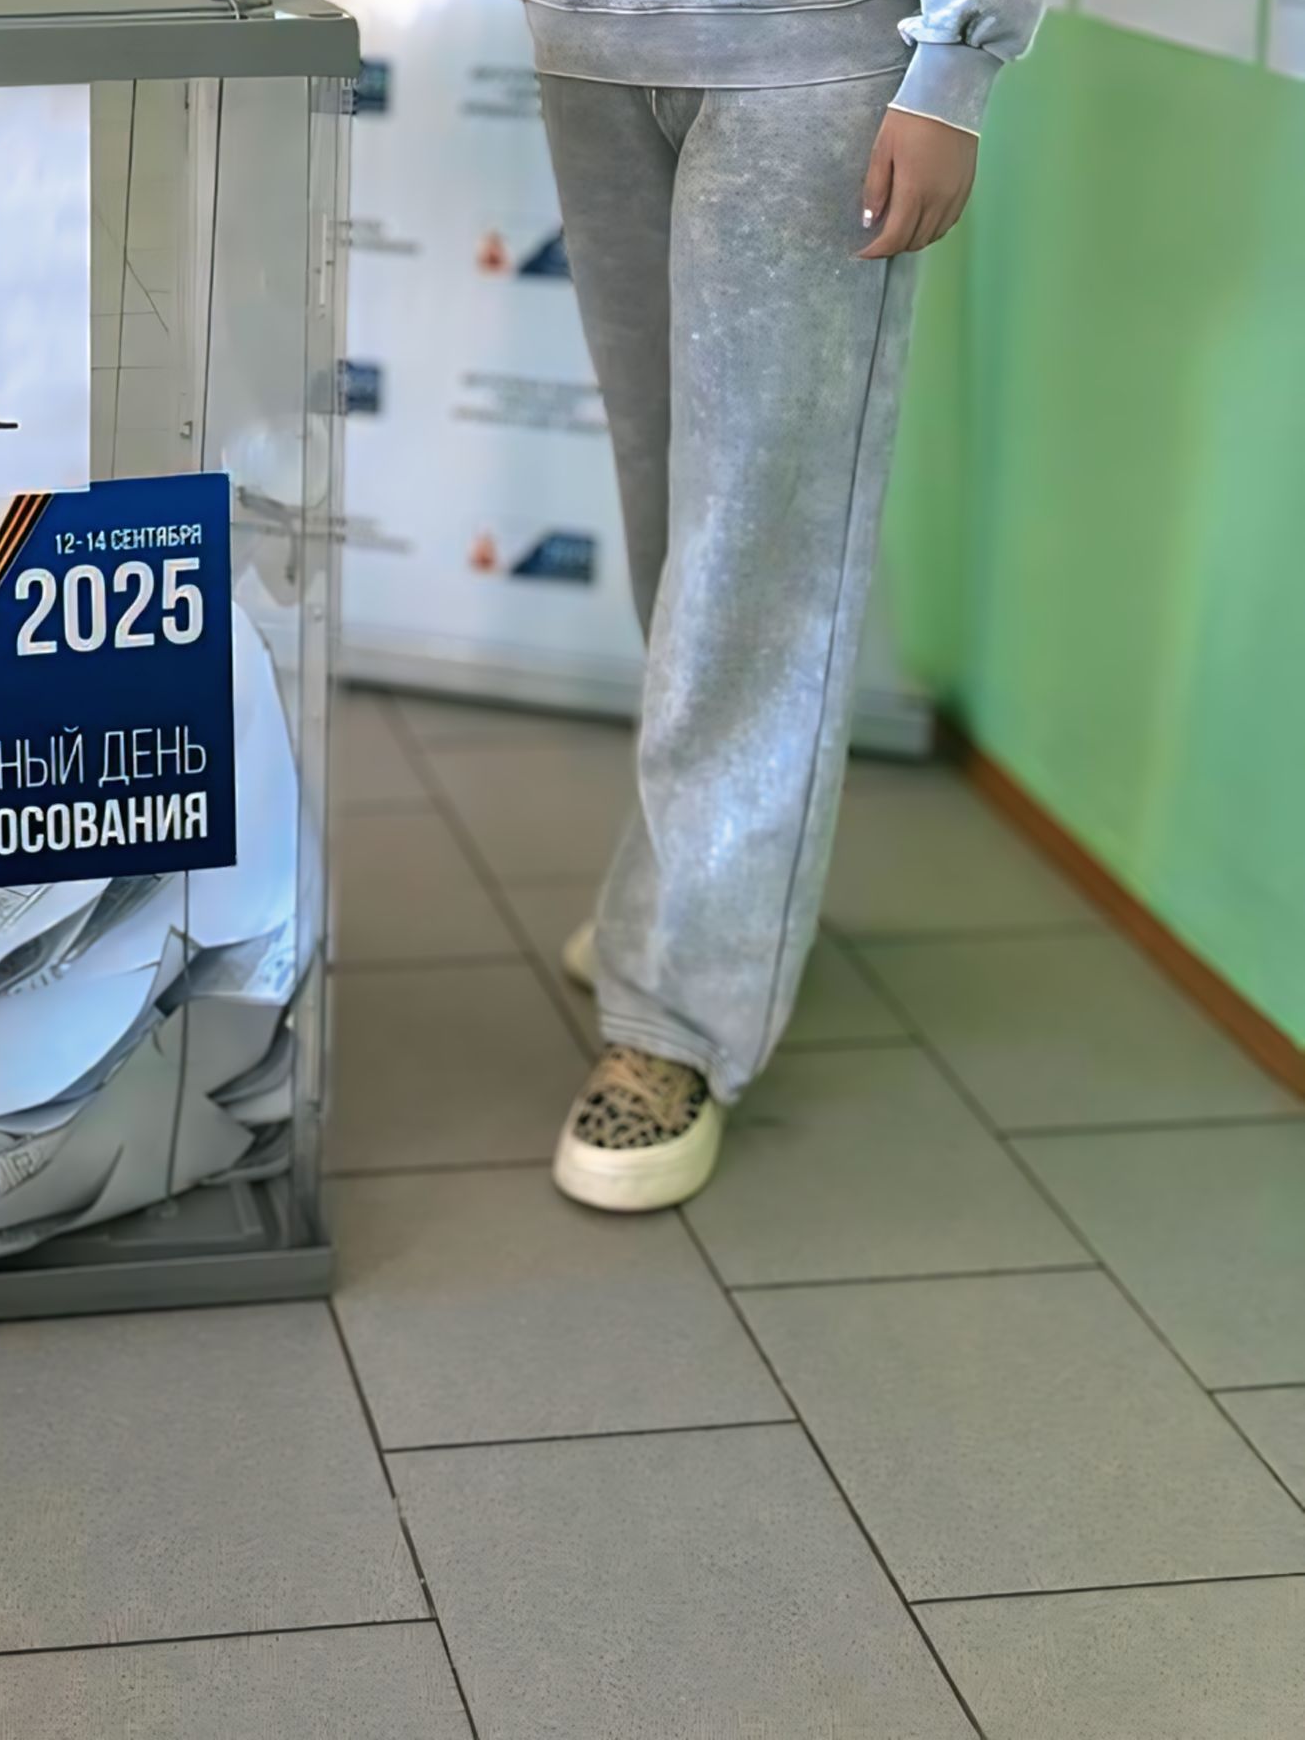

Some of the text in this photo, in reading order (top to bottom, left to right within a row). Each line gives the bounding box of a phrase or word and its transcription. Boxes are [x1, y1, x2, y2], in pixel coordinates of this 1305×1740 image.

[55, 530, 107, 555] 12-14
[14, 557, 204, 656] 2025
[98, 725, 206, 788] ДЕНЬ
